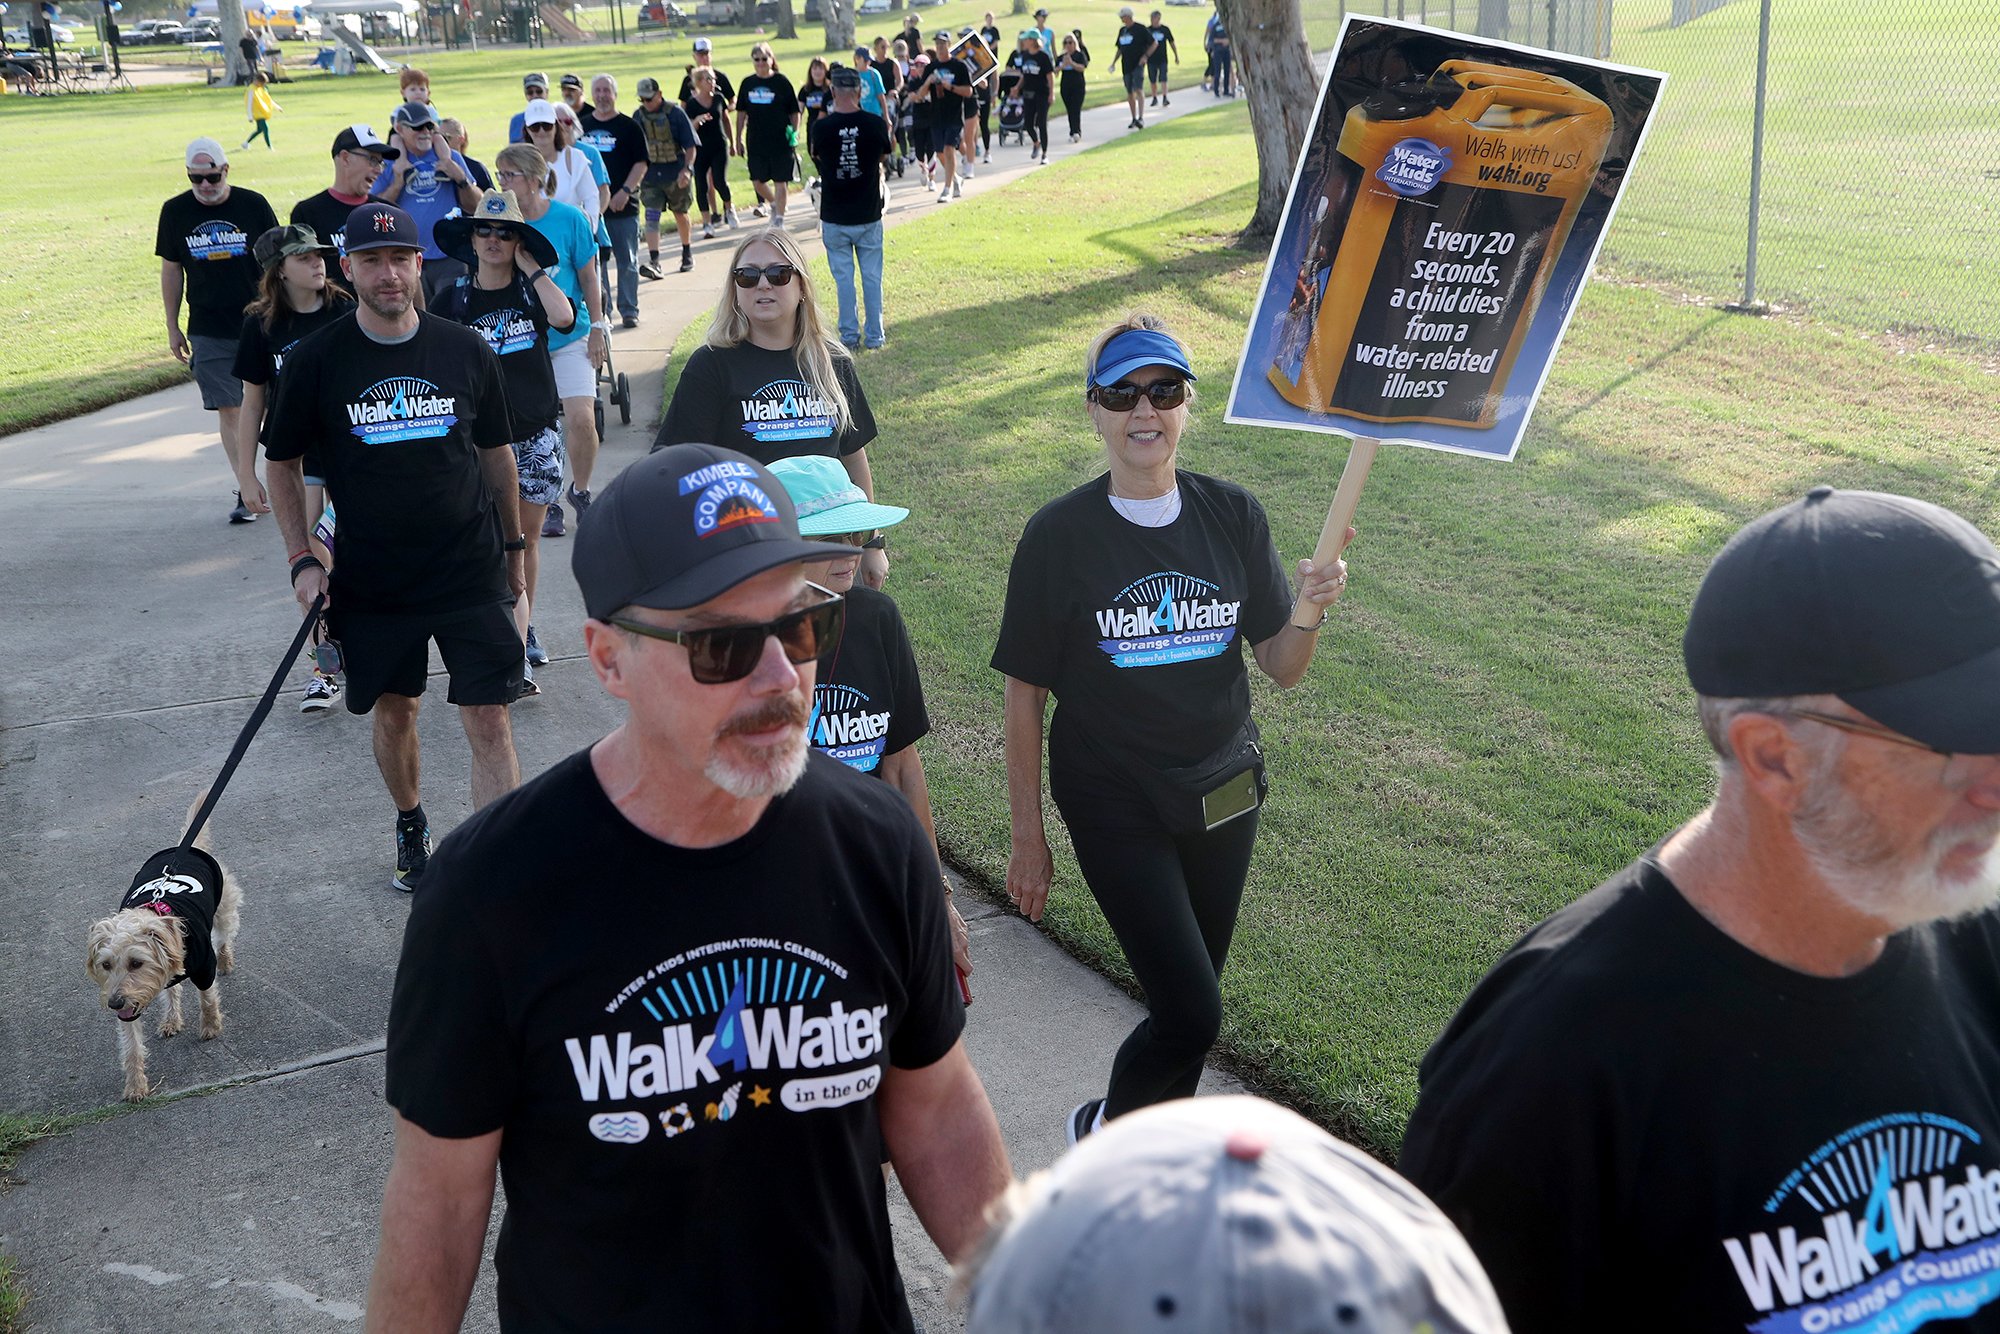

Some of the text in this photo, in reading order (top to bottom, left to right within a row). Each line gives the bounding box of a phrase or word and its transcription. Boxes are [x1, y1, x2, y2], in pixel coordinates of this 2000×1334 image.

[1394, 147, 1440, 170] Water
[1465, 134, 1583, 170] Walk with us!
[1383, 175, 1430, 191] INTERNATIONAL
[1478, 162, 1552, 193] w4ki.org
[1423, 222, 1516, 259] Every 20
[1410, 258, 1500, 288] seconds,
[1390, 285, 1504, 315] a child dies
[1404, 315, 1469, 342] from a
[1355, 343, 1499, 374] water-related
[1380, 372, 1448, 399] illness
[364, 418, 444, 434] Orange County
[758, 418, 829, 430] Orange County
[684, 462, 752, 490] KIMBLE
[698, 482, 776, 529] COMPANY
[1113, 586, 1130, 602] WATER
[1133, 577, 1146, 586] KIDS
[1146, 571, 1186, 580] INTERNATIONAL
[1186, 575, 1220, 591] CELEBRATES
[1118, 632, 1224, 651] Orange County
[1124, 656, 1135, 664] Mile
[1136, 654, 1154, 664] Square
[1154, 652, 1167, 661] Park
[1170, 649, 1192, 660] Fountain
[1208, 646, 1215, 654] CA
[838, 684, 870, 701] CELEBRATES
[826, 744, 876, 758] County
[604, 937, 849, 1014] WATER 4 KIDS INTERNATIONAL CELEBRATES
[795, 1076, 876, 1104] in the OC
[1762, 1168, 1804, 1214] WATER
[1802, 1160, 1812, 1173] 4
[1808, 1139, 1838, 1166] KIDS
[1835, 1111, 1922, 1147] INTERNATIONAL
[1722, 1149, 2000, 1312] Walk4Wate
[1800, 1278, 1901, 1334] Orange
[1902, 1243, 2000, 1287] County
